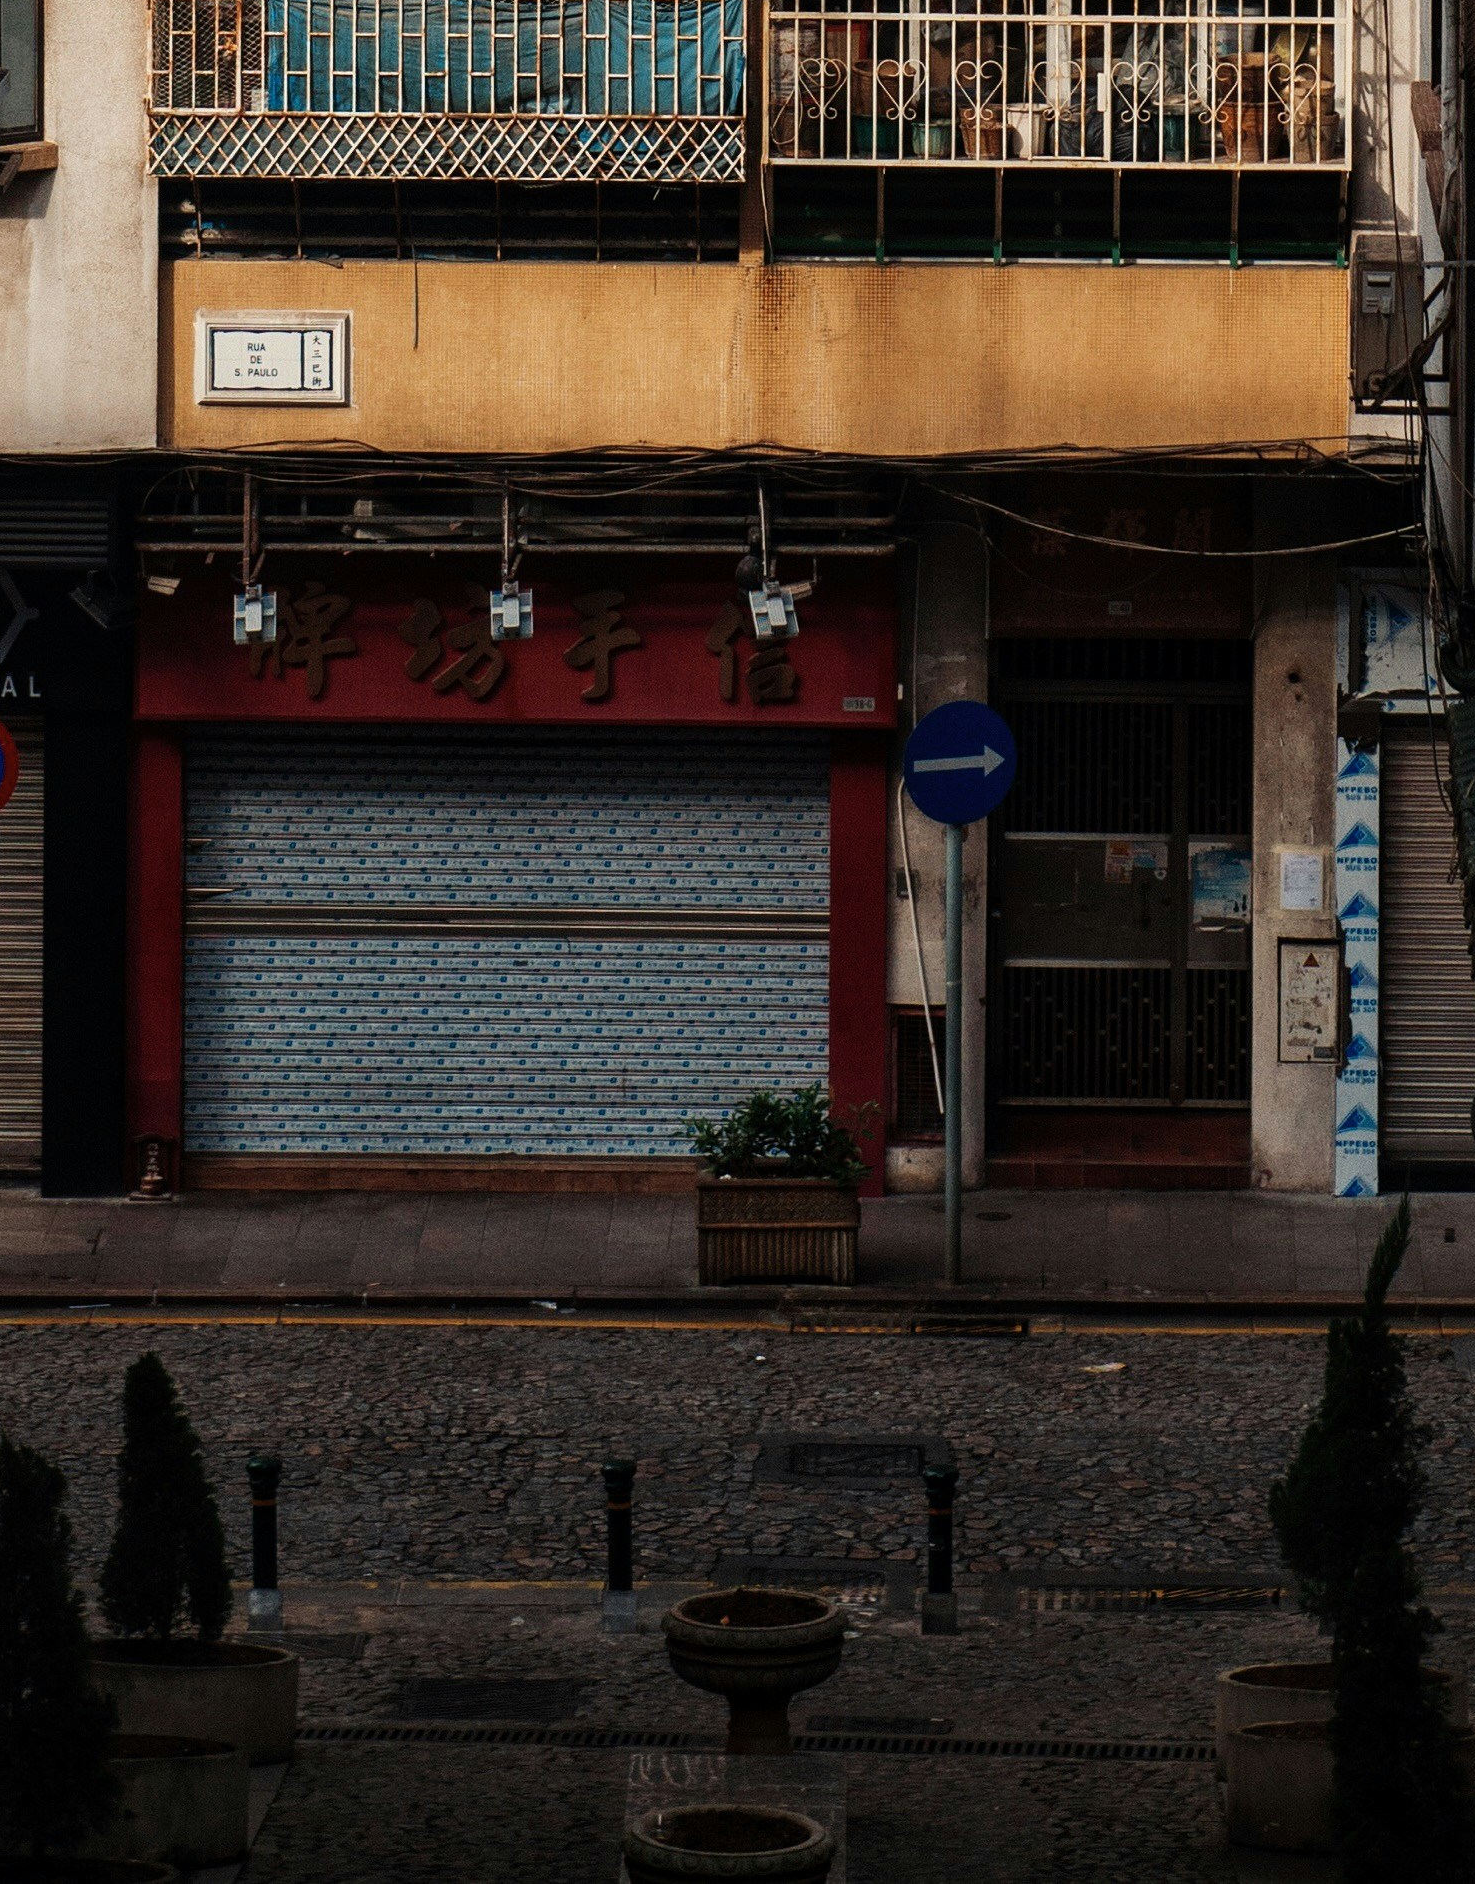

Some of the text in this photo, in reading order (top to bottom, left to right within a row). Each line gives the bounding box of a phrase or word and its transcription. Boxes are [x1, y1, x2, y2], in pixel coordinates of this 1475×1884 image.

[247, 342, 266, 352] RUA
[249, 355, 262, 365] DE
[311, 335, 322, 387] 大三巴街
[234, 368, 279, 377] S. PAULO
